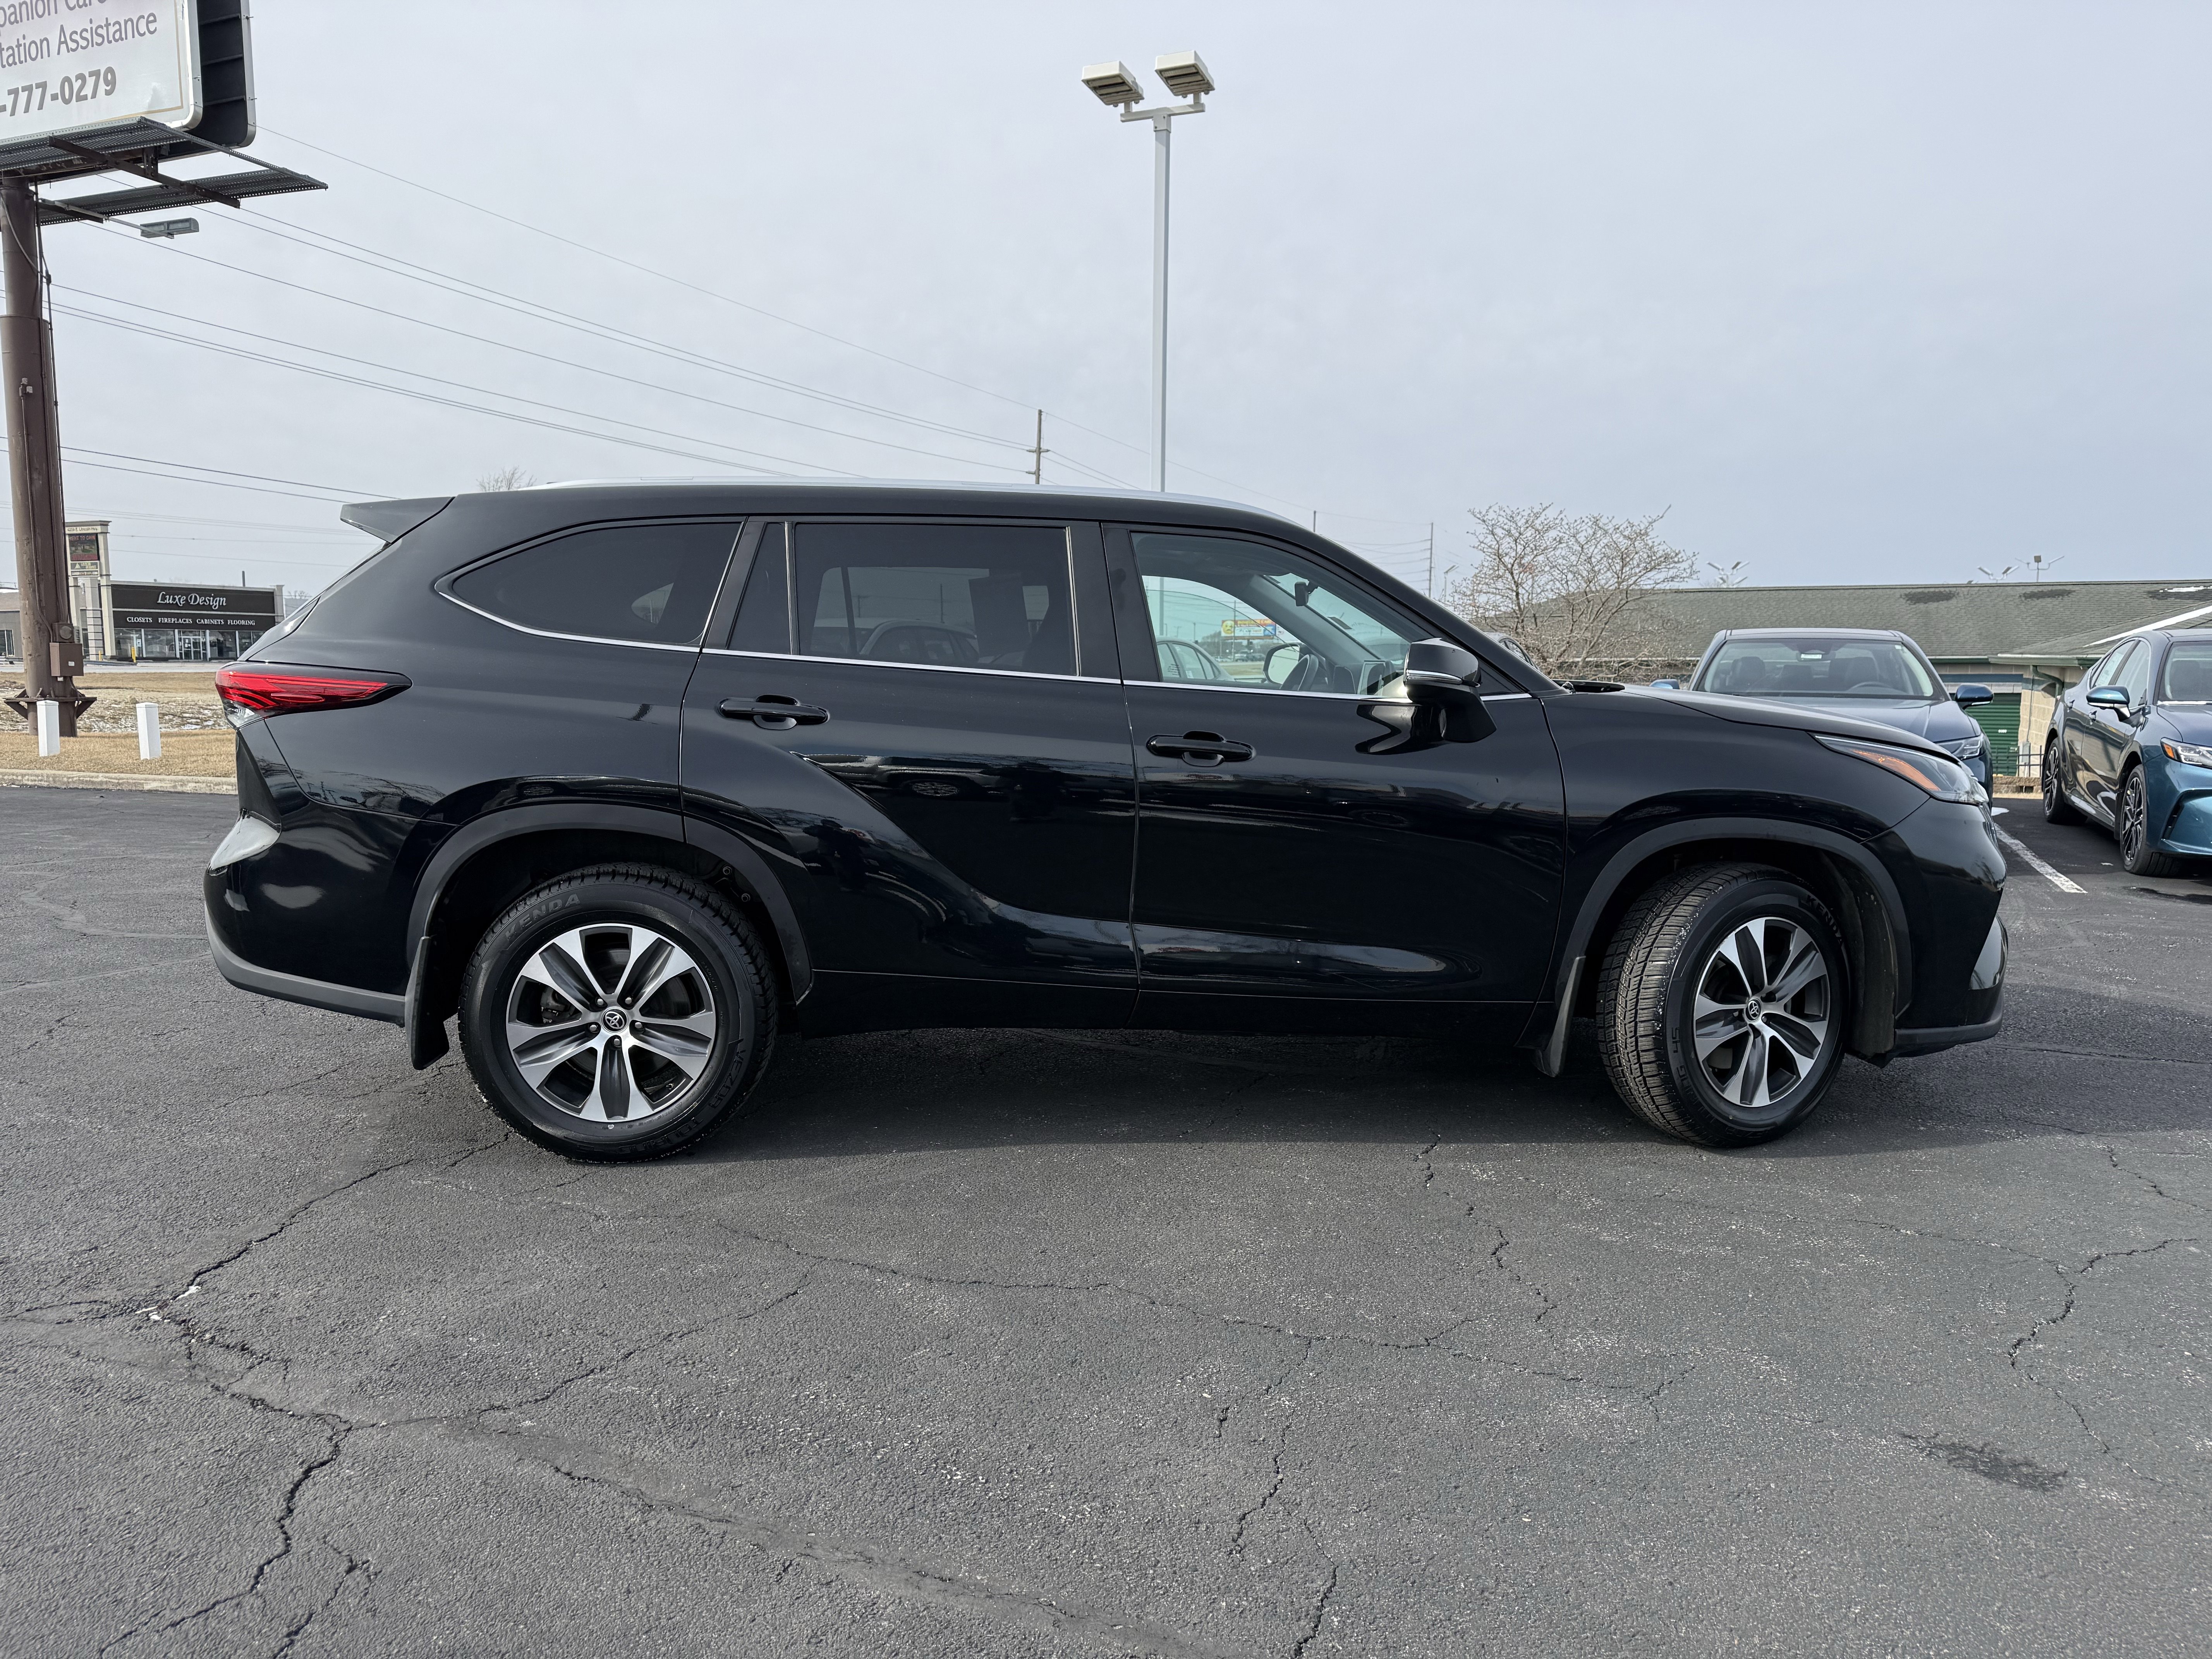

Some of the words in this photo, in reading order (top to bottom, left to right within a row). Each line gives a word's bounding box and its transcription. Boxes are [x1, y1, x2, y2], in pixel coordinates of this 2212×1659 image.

[57, 12, 157, 55] Assistance
[157, 591, 186, 606] Luxe
[188, 593, 227, 610] Design
[505, 893, 581, 941] KENDA
[1806, 894, 1843, 946] KENDA
